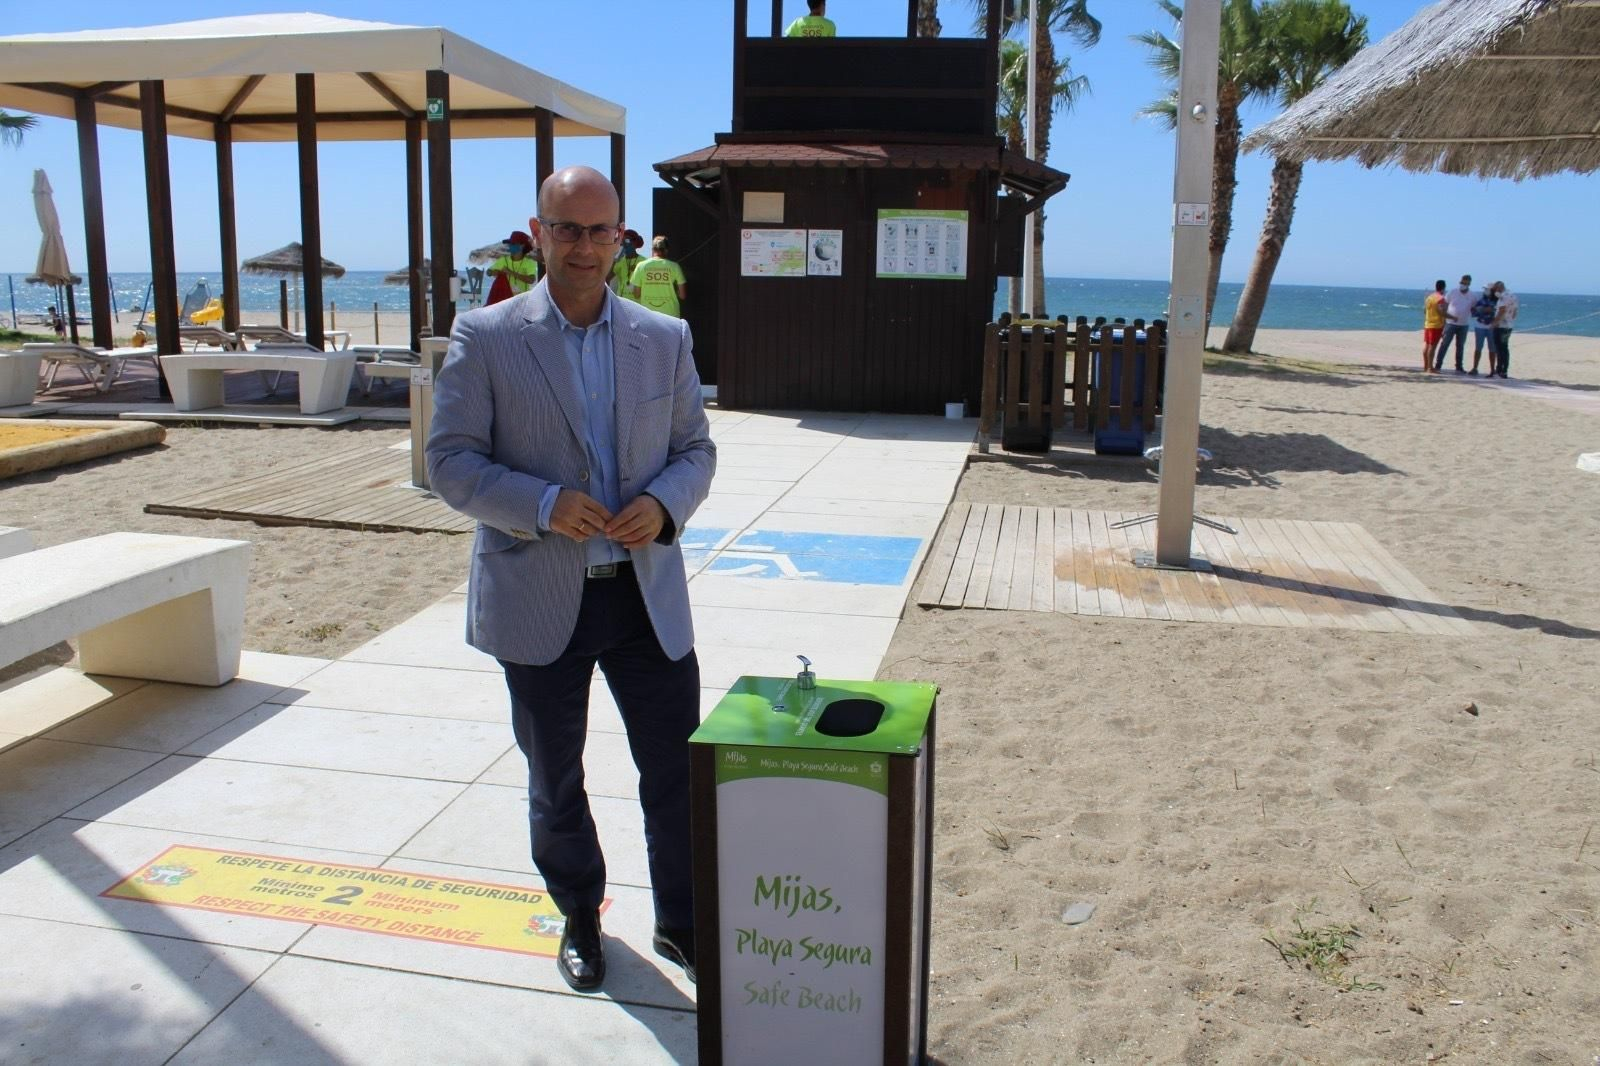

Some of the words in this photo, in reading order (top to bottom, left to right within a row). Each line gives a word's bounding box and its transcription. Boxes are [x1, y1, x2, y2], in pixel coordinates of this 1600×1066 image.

[646, 272, 669, 281] SOS
[783, 759, 800, 773] Playa
[216, 854, 291, 872] RESPETE
[290, 863, 315, 875] LA
[316, 866, 408, 888] DISTANCIA
[411, 879, 435, 890] DE
[438, 882, 543, 905] SEGURIDAD
[249, 884, 318, 899] metros
[321, 885, 364, 906] 2
[371, 891, 461, 912] Minimum
[753, 874, 842, 918] Mijas,
[363, 899, 434, 915] meters
[191, 895, 272, 914] RESPECT
[274, 905, 313, 918] THE
[317, 910, 387, 926] SAFETY
[387, 920, 485, 942] DISTANCE
[735, 928, 793, 966] Playa
[799, 936, 872, 969] Segura
[743, 981, 790, 1008] Safe
[797, 986, 862, 1014] Beach
